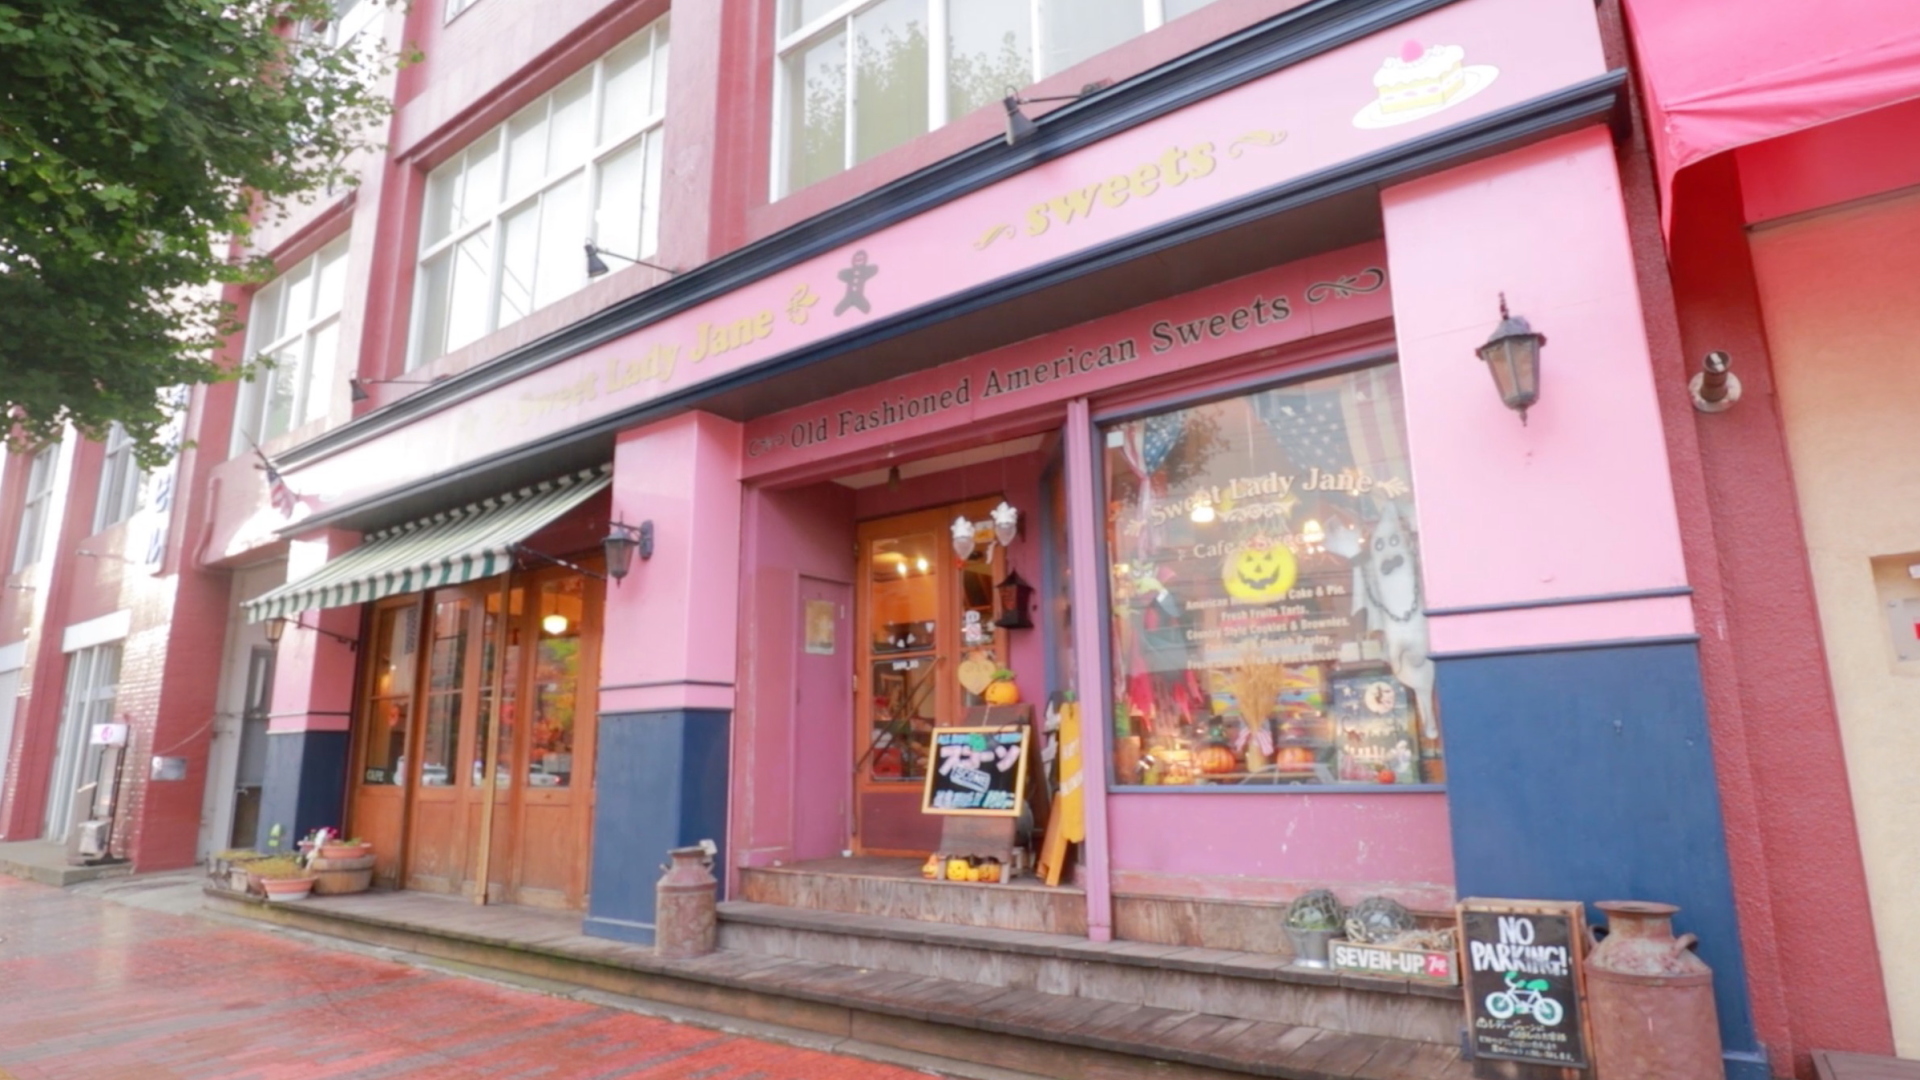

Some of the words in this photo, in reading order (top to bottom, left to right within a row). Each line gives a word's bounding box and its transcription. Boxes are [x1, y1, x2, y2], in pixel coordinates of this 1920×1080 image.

[1025, 141, 1217, 237] sweets
[518, 371, 599, 427] Sweet
[605, 343, 680, 394] Lady
[689, 310, 775, 363] Jane
[790, 417, 829, 449] Old
[838, 378, 971, 438] Fashioned
[983, 337, 1138, 399] American
[1149, 296, 1292, 354] Sweets
[1229, 472, 1295, 501] Lady
[1302, 467, 1373, 493] Jane
[1193, 539, 1236, 559] Cafe
[1185, 598, 1229, 611] American
[1288, 588, 1314, 601] Cake
[1221, 608, 1249, 621] Fresh
[1250, 622, 1288, 635] Cookies
[1498, 916, 1535, 946] NO
[1335, 946, 1425, 974] SEVEN-UP
[1470, 940, 1568, 976] PARKING!
